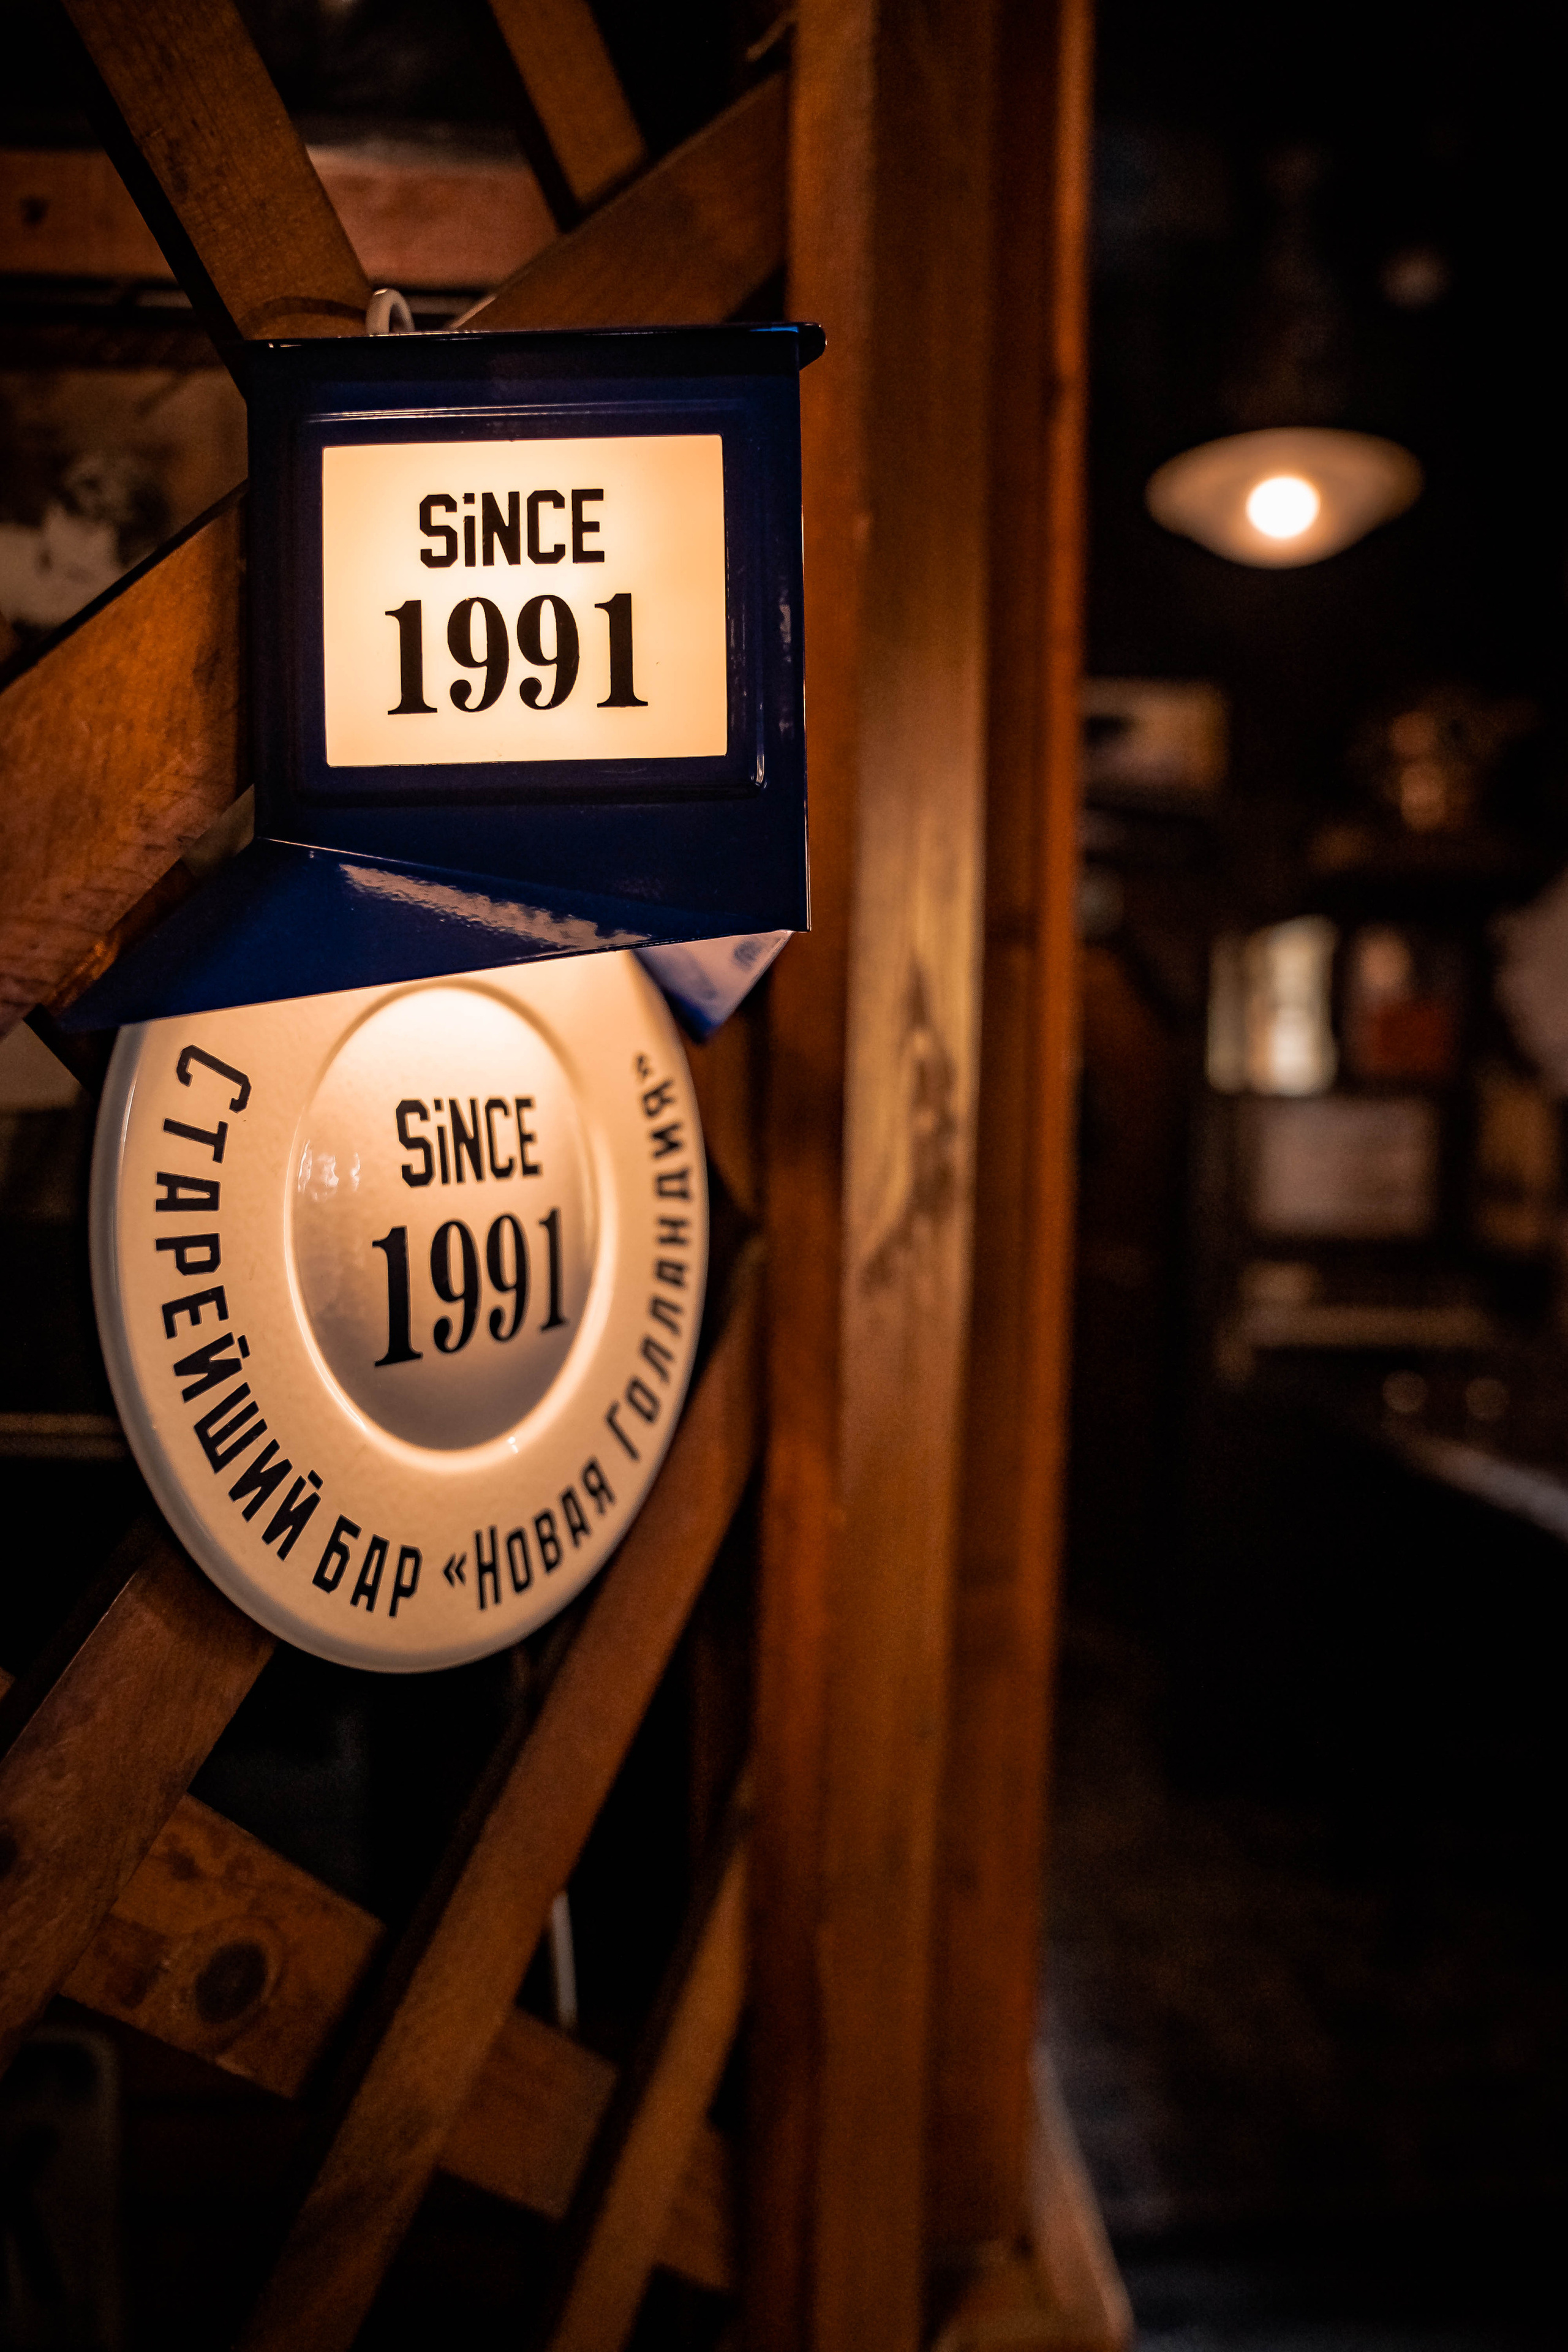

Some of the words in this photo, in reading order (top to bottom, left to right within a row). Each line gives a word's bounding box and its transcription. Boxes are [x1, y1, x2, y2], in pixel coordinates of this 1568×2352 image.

[385, 592, 648, 715] 1991
[372, 1207, 568, 1368] 1991
[311, 1514, 423, 1618] БАР
